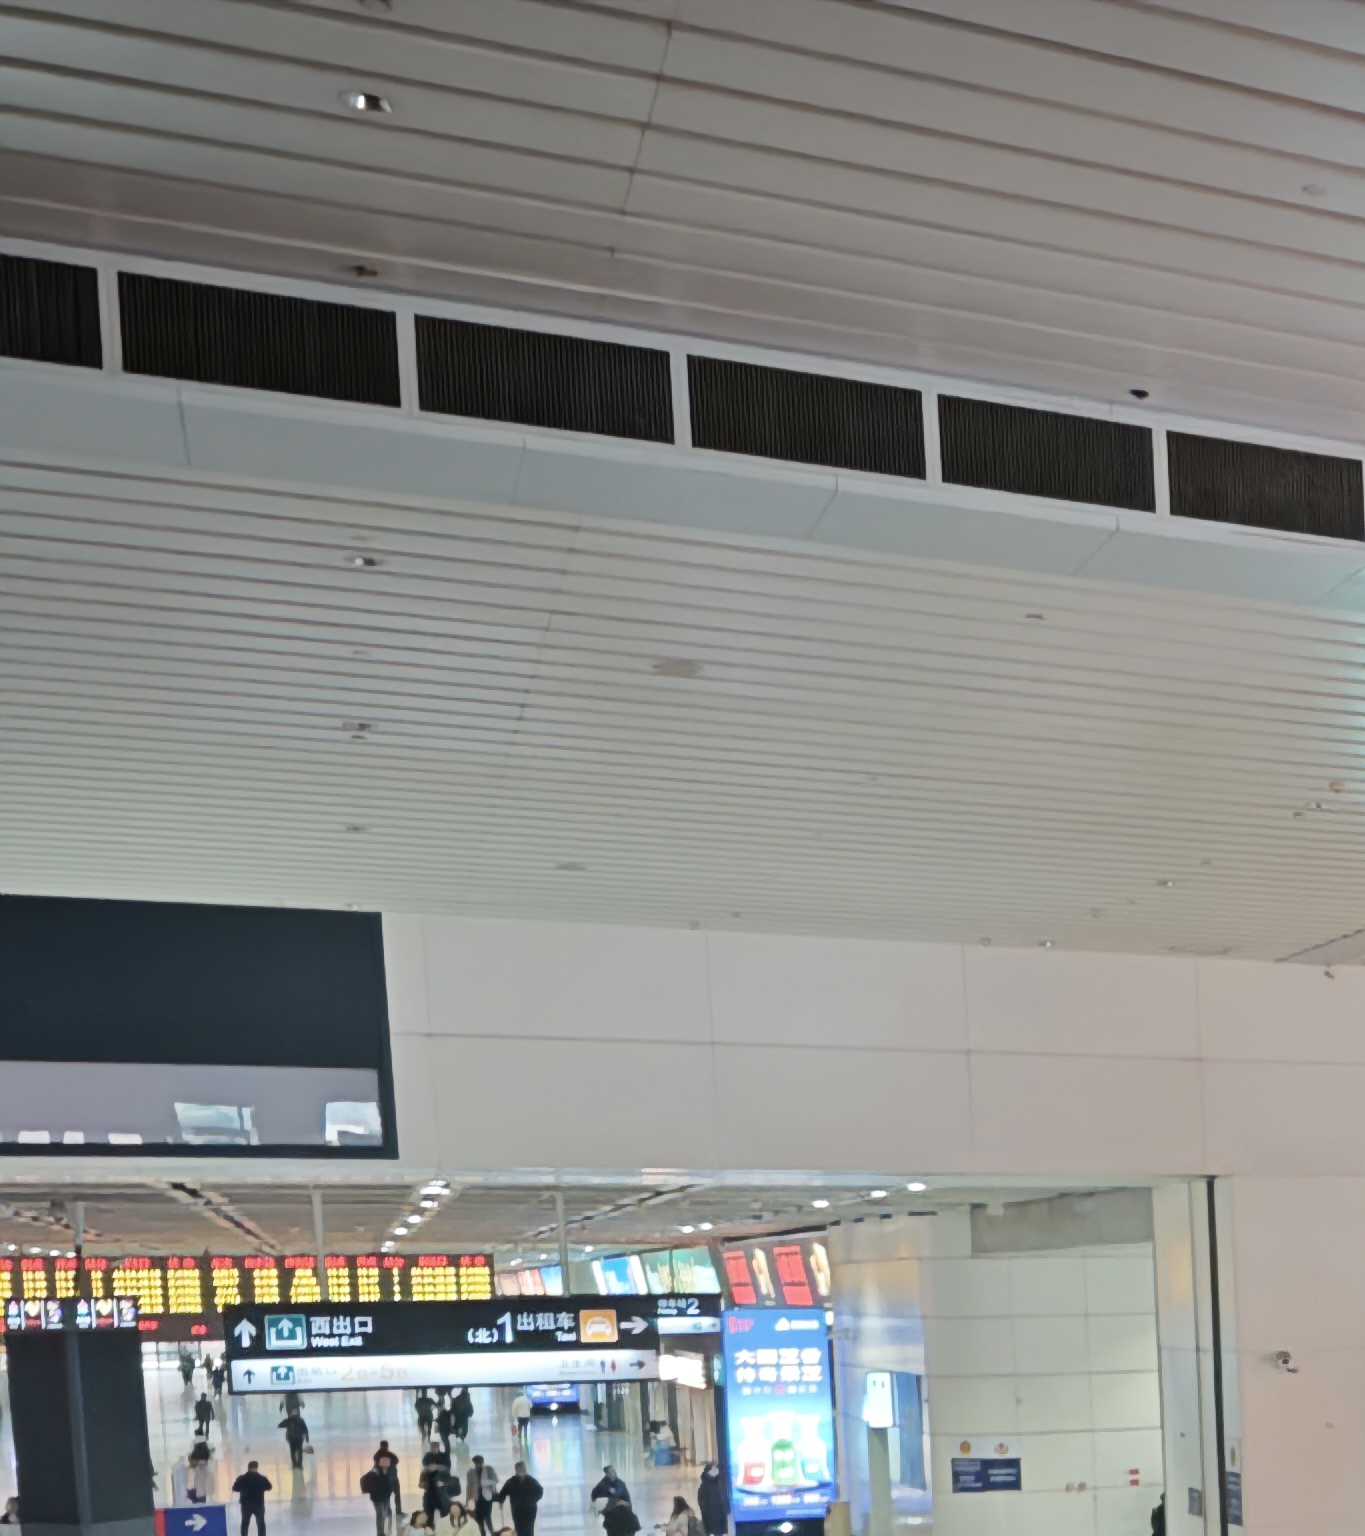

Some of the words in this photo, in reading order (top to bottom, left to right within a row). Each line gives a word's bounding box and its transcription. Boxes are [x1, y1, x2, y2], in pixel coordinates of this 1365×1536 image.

[687, 1297, 701, 1315] 2
[310, 1315, 374, 1334] 西出口
[517, 1311, 576, 1331] 出租车
